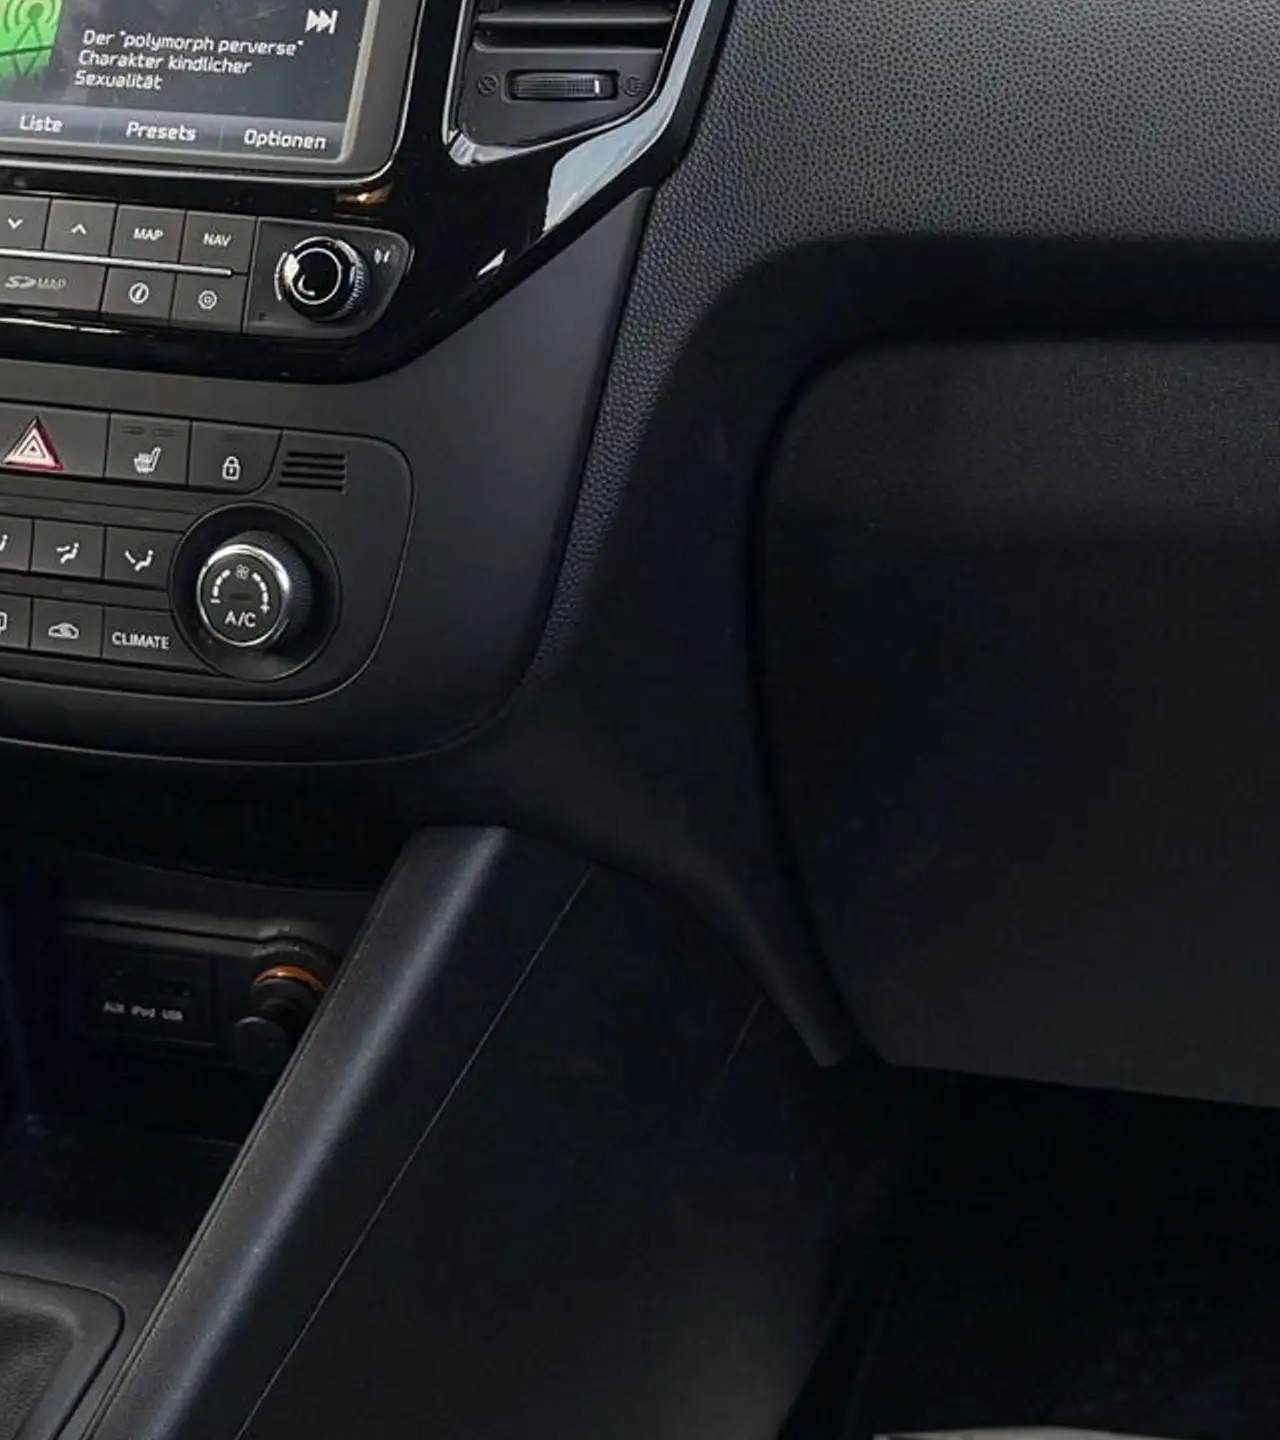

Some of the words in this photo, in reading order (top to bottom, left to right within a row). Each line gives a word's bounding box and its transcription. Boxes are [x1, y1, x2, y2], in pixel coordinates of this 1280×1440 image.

[82, 30, 115, 46] Der
[78, 50, 163, 68] Charakter
[168, 54, 252, 74] kindlicher
[74, 70, 163, 91] Sexualität
[19, 113, 63, 134] Liste
[126, 121, 197, 143] Presets
[243, 127, 327, 152] Optionen
[133, 227, 164, 241] MAP
[203, 233, 231, 247] NAV
[224, 612, 257, 628] A/C
[112, 632, 170, 649] CLIMATE
